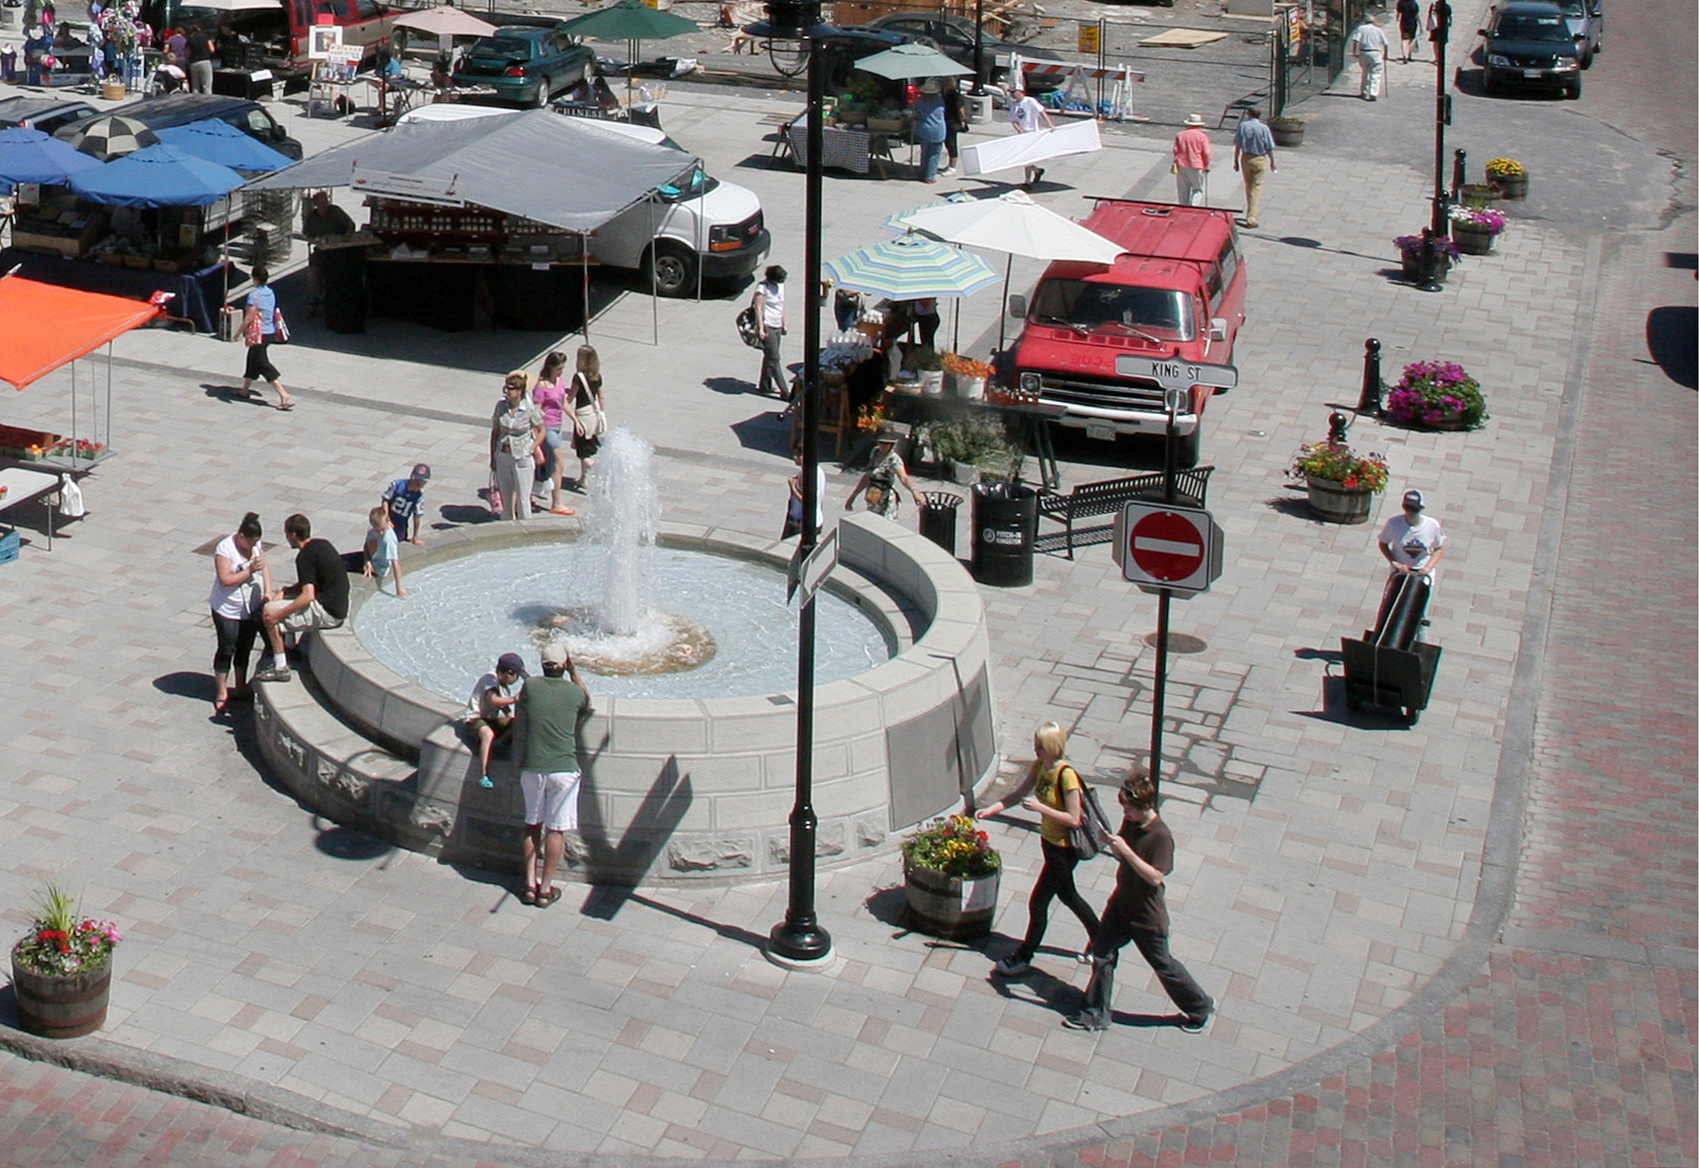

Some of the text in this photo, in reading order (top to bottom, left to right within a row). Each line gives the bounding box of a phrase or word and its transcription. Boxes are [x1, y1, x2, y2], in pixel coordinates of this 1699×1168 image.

[555, 107, 604, 119] CHINESE
[1152, 362, 1202, 380] KING ST
[391, 496, 413, 517] 21
